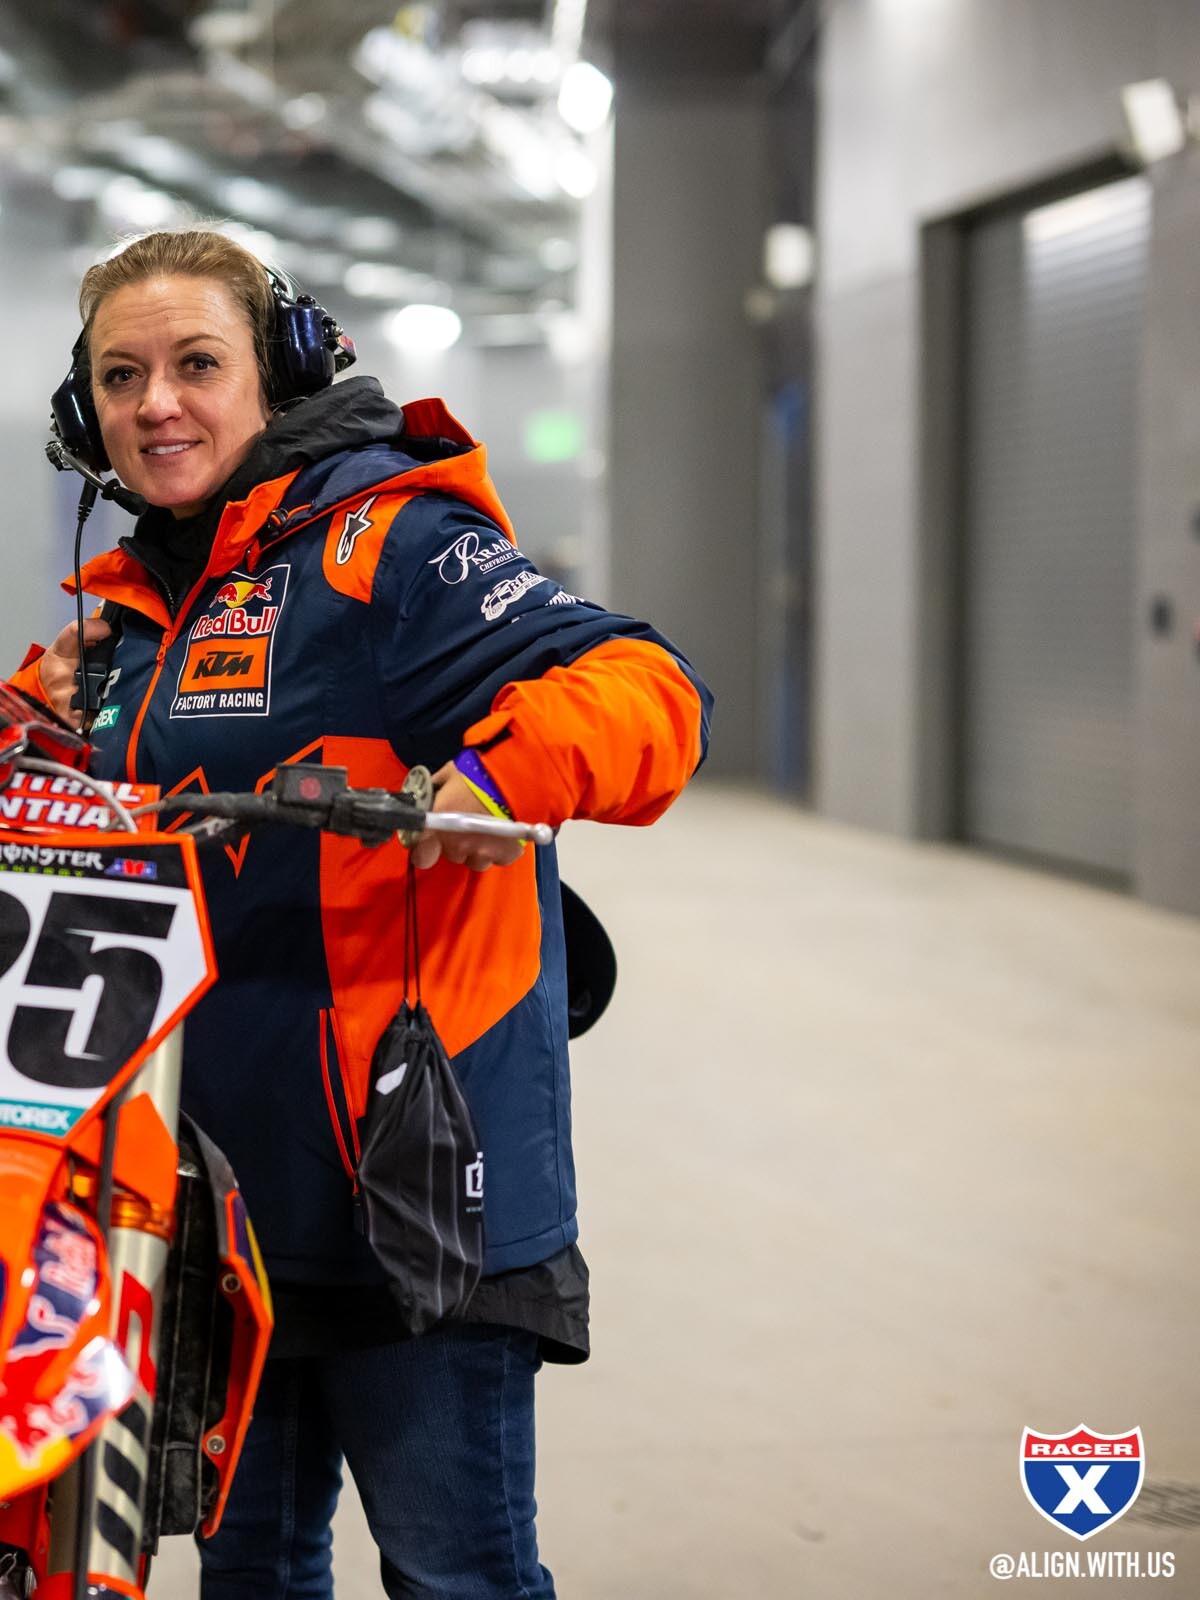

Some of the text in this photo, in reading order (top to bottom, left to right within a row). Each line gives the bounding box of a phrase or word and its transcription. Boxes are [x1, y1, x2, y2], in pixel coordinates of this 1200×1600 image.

[479, 552, 514, 572] CHEVROLET
[192, 606, 279, 640] Red Bull
[191, 651, 255, 680] KTM
[175, 692, 264, 711] FACTORY RACING
